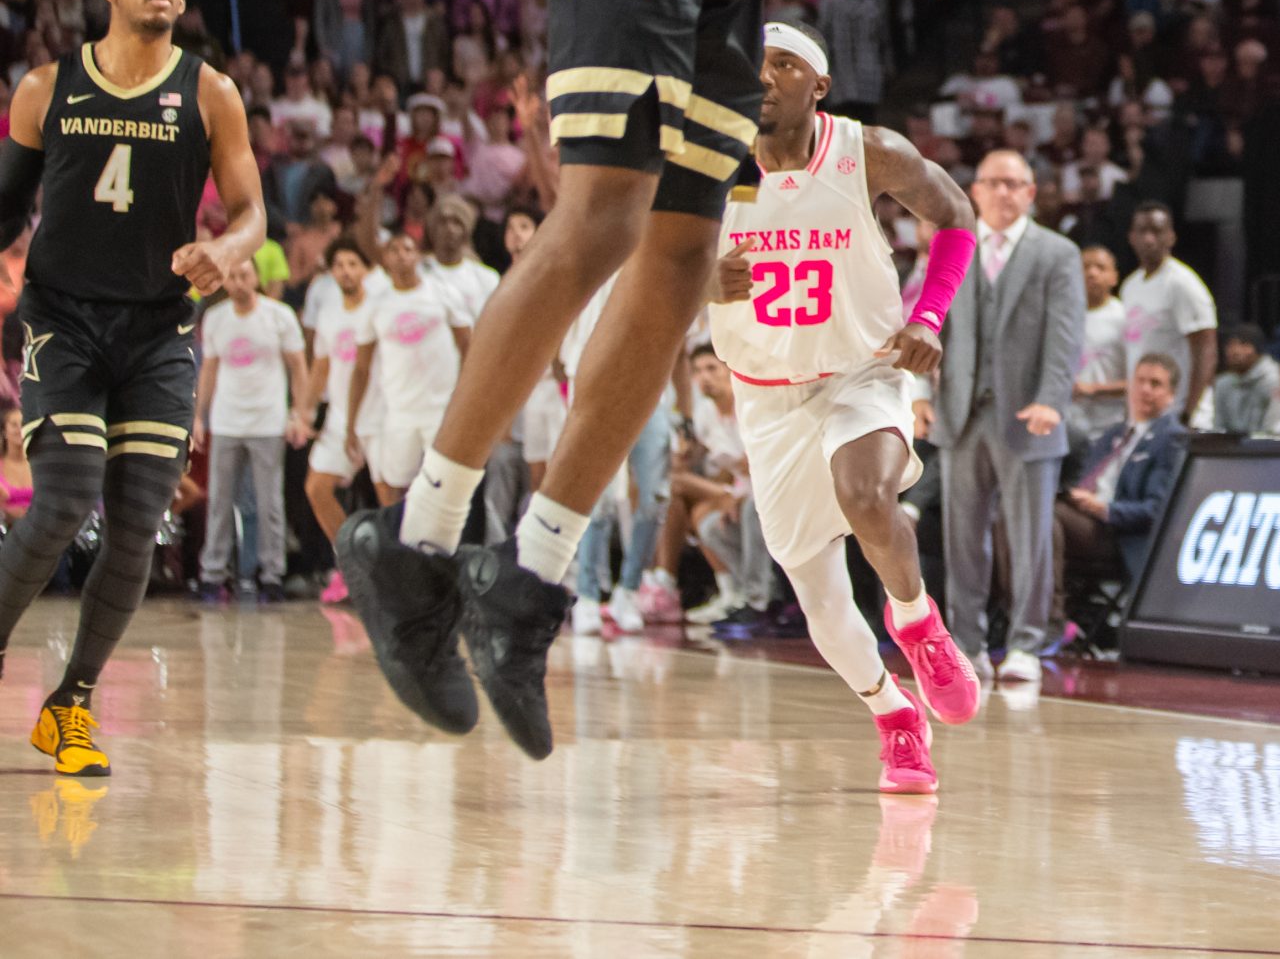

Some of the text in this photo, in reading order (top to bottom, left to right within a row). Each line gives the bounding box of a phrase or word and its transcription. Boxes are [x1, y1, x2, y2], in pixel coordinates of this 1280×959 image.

[60, 117, 180, 143] VANDERBILT
[94, 143, 134, 213] 4
[729, 228, 852, 253] TEXAS A&M
[752, 259, 834, 327] 23
